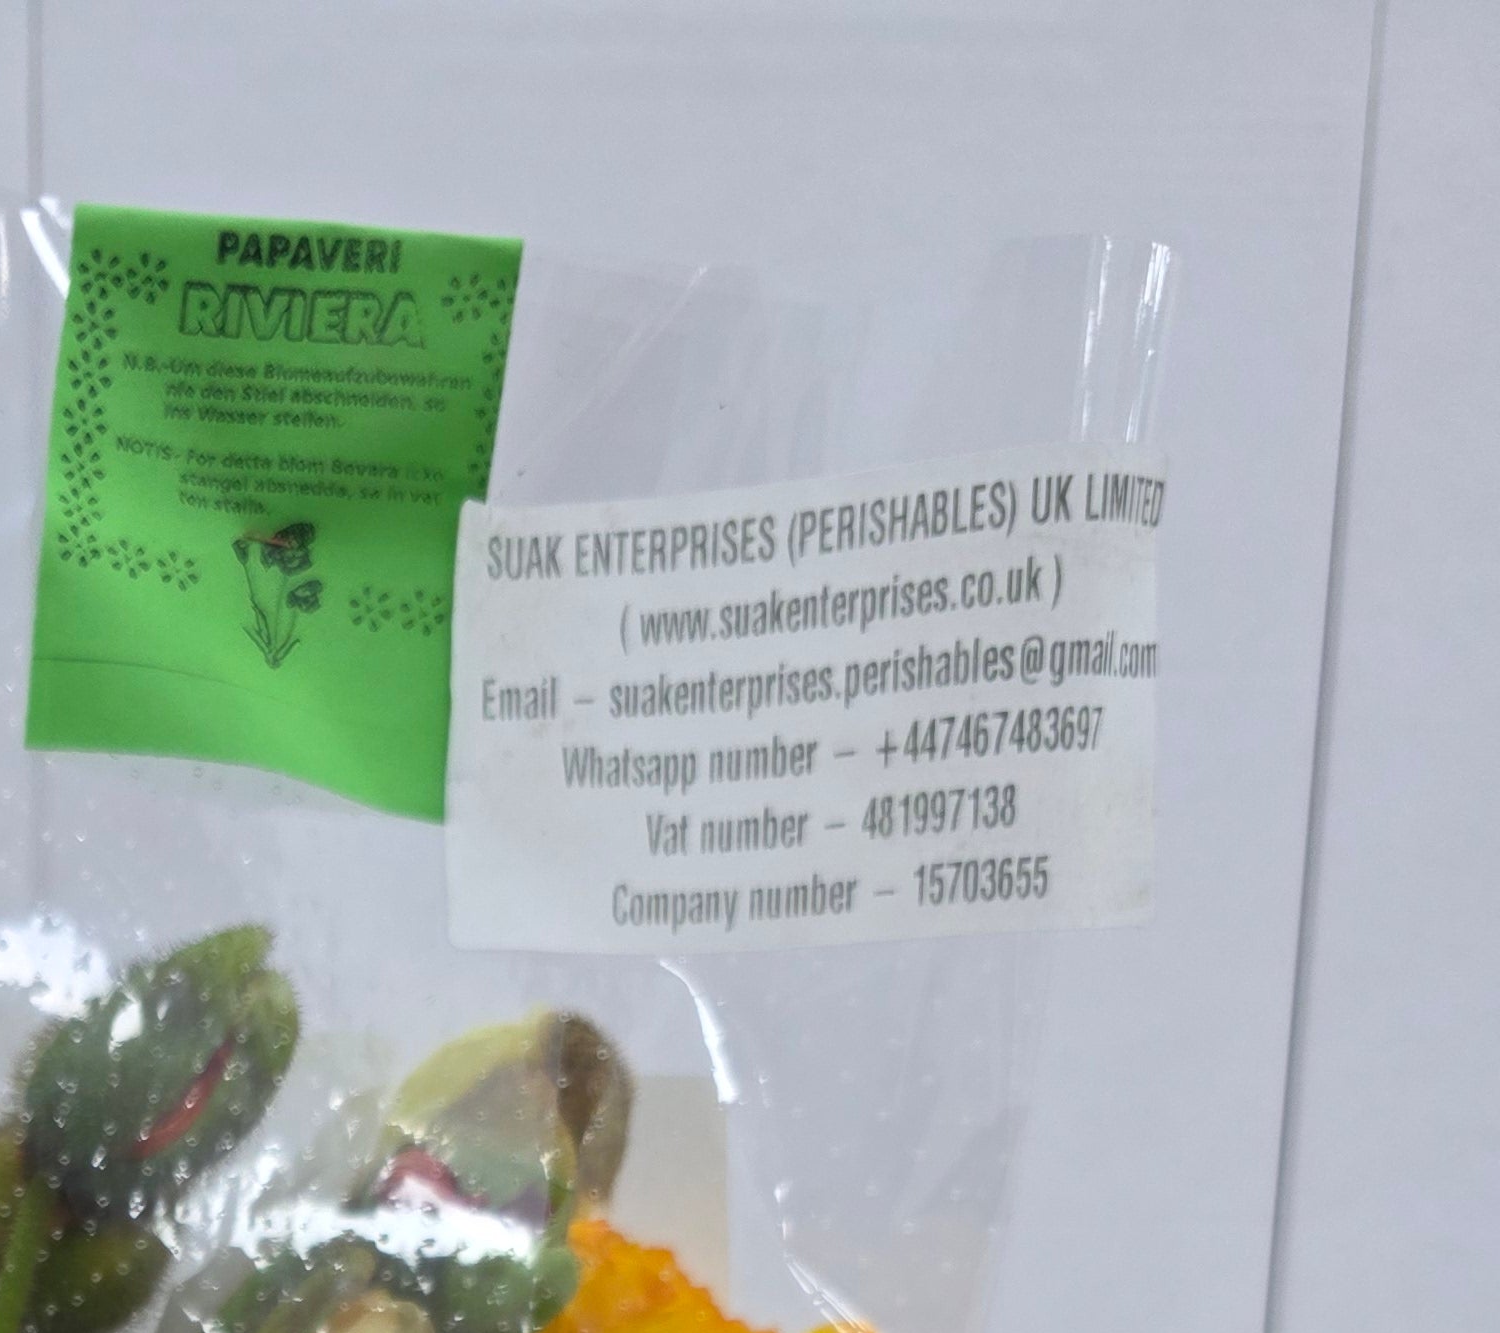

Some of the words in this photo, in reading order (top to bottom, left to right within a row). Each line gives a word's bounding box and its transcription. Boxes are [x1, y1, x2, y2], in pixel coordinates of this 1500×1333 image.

[216, 230, 405, 275] PAPAVERI
[178, 280, 428, 350] RIVIERA
[488, 535, 562, 579] SUAK
[576, 515, 775, 576] ENTERPRISES
[787, 480, 1017, 564] (PERISHABLES)
[1031, 474, 1074, 524] UK
[1085, 473, 1165, 528] LIMITED
[638, 556, 1043, 646] www.suakenterprises.co.uk
[483, 677, 557, 718] Email
[608, 628, 1160, 720] suakenterprises.perishables@gmail.com
[563, 746, 697, 792] Whatsapp
[710, 735, 818, 780] number
[878, 705, 1103, 766] +447467483697
[647, 814, 688, 853] Vat
[701, 807, 809, 851] number
[863, 783, 1016, 837] 481997138
[613, 884, 738, 931] Company
[750, 874, 857, 916] number
[916, 855, 1049, 905] 15703655
